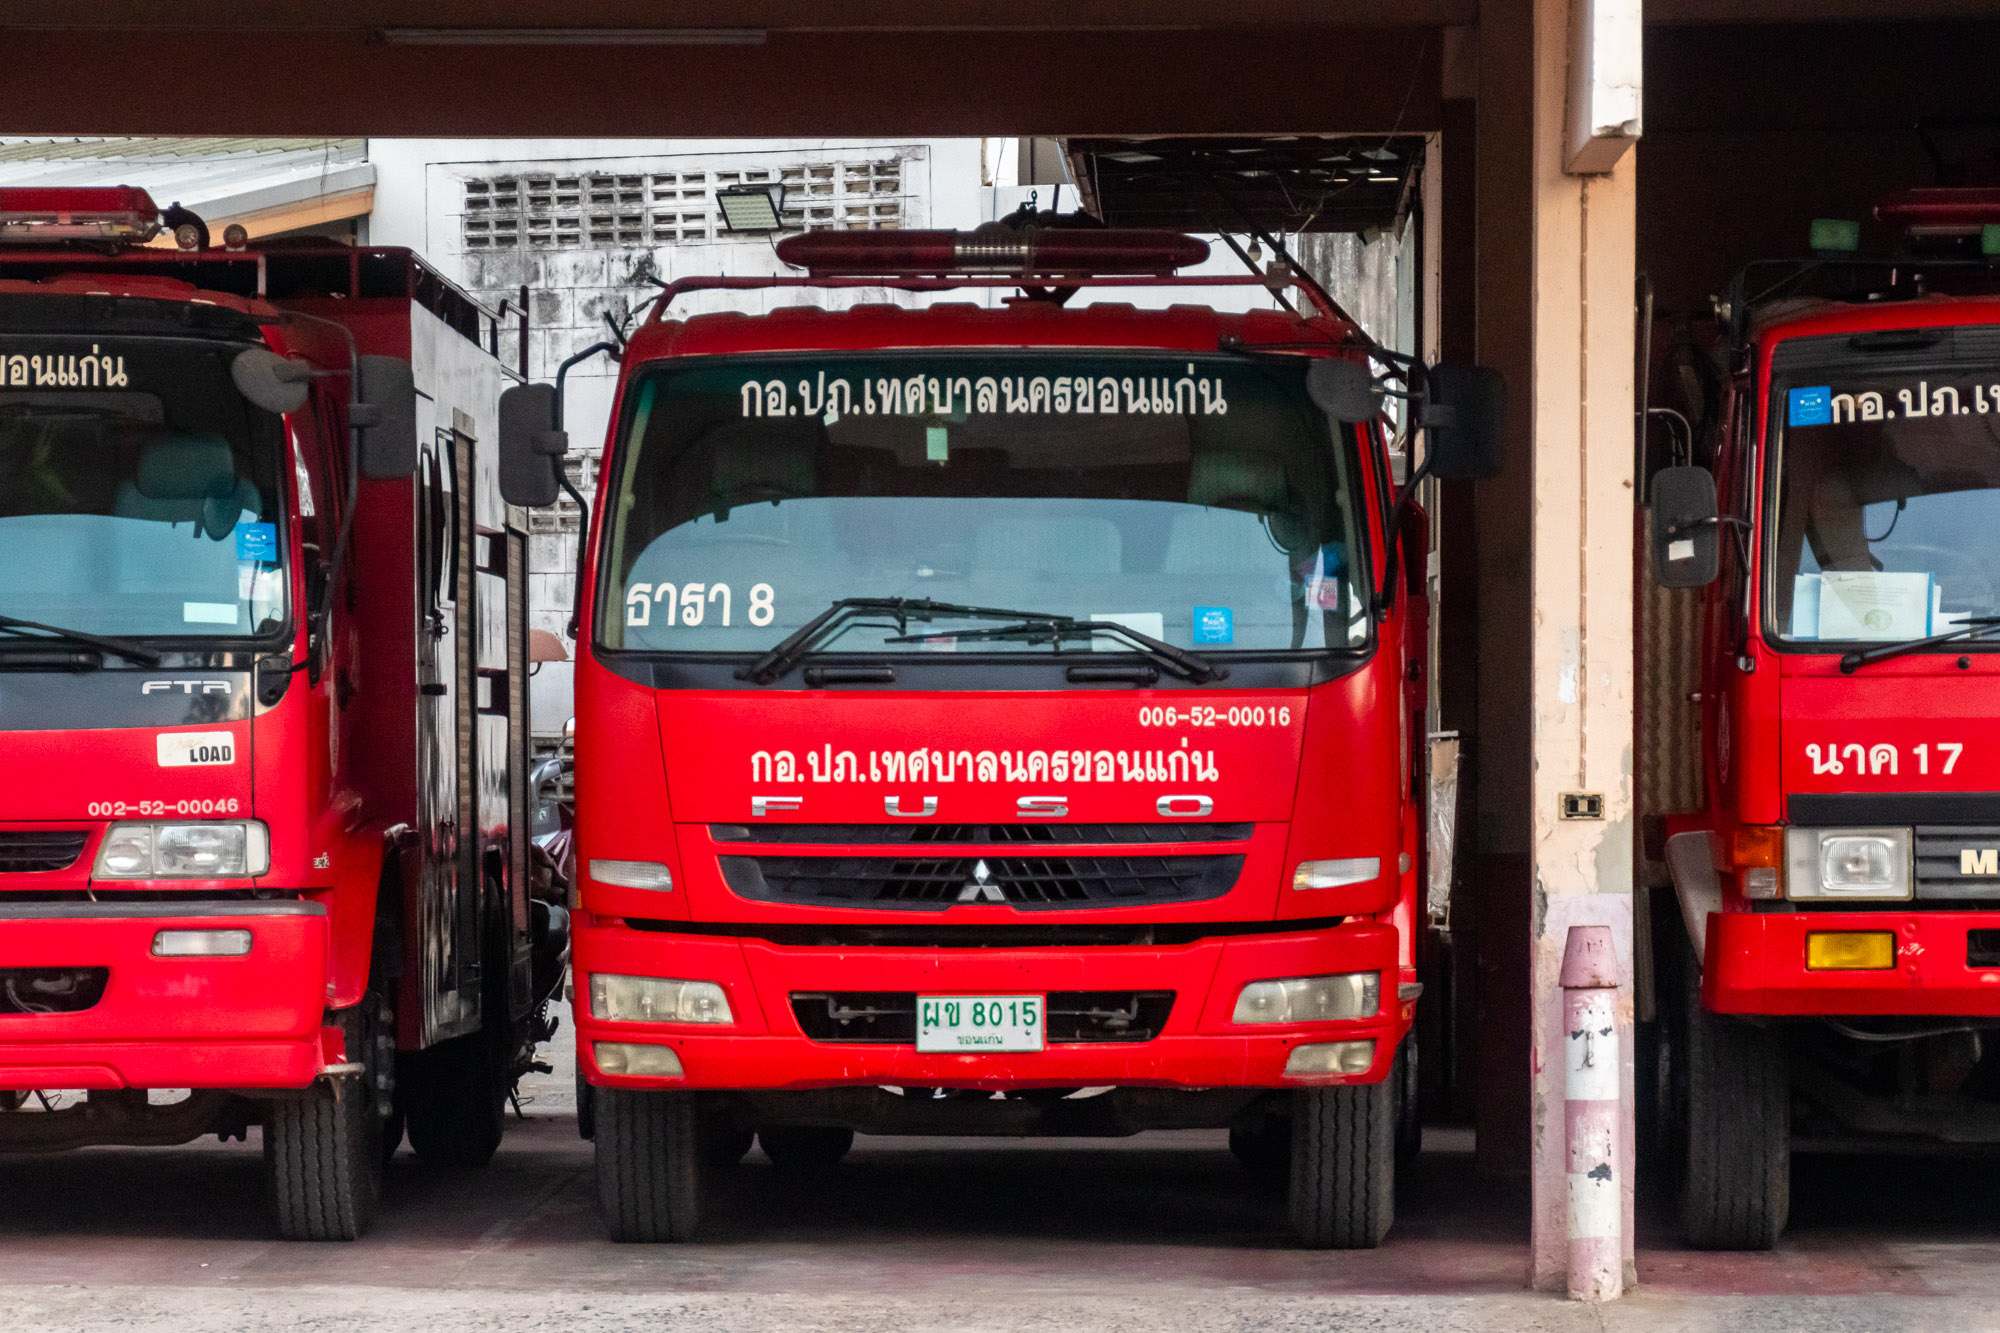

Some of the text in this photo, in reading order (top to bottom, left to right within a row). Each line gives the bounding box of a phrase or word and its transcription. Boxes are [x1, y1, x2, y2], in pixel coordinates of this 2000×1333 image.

[740, 362, 1228, 417] กอ.ปภ.เทศบาลนครขอนแก่น
[626, 582, 775, 627] ธารา 8
[141, 680, 232, 695] FTR
[1138, 706, 1291, 727] 006-52-00016
[189, 745, 232, 763] LOAD
[750, 736, 1220, 783] กอ.ปภ.เทศบาลนครขอนแก่น
[1805, 743, 1964, 775] นาค 17
[87, 798, 239, 817] 002-52-00046
[751, 795, 1214, 818] FUSO
[923, 1001, 1037, 1027] ผข 8015
